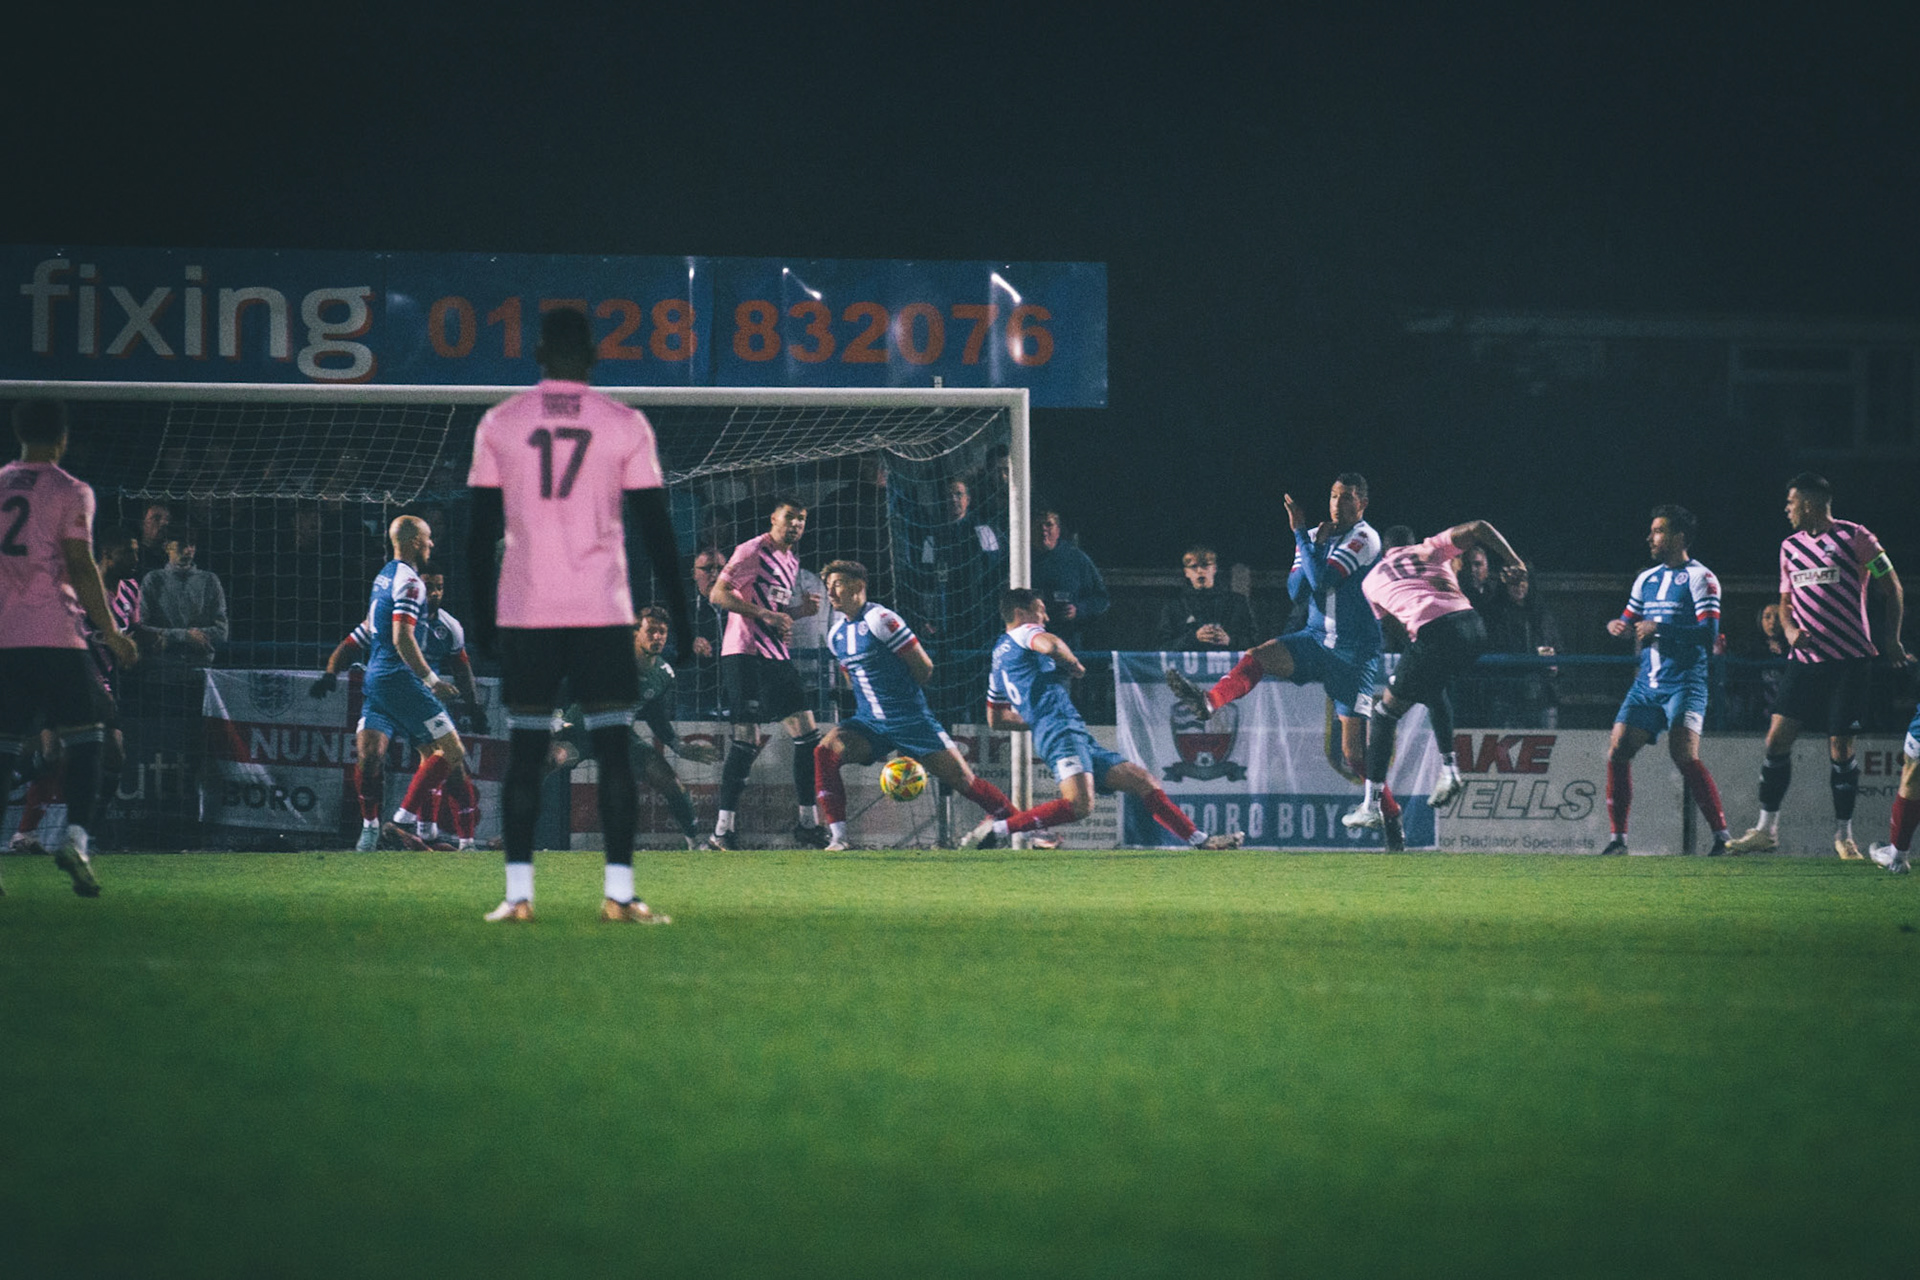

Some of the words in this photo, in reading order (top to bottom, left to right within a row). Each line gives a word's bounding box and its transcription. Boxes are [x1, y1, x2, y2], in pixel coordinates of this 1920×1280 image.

[20, 258, 376, 382] fixing
[732, 299, 1054, 367] 832076
[527, 428, 592, 499] 17
[1378, 552, 1426, 580] 10
[1001, 669, 1022, 706] 6
[250, 727, 482, 776] NUNETN
[1461, 834, 1519, 848] Radiator
[1523, 834, 1595, 849] Specialists
